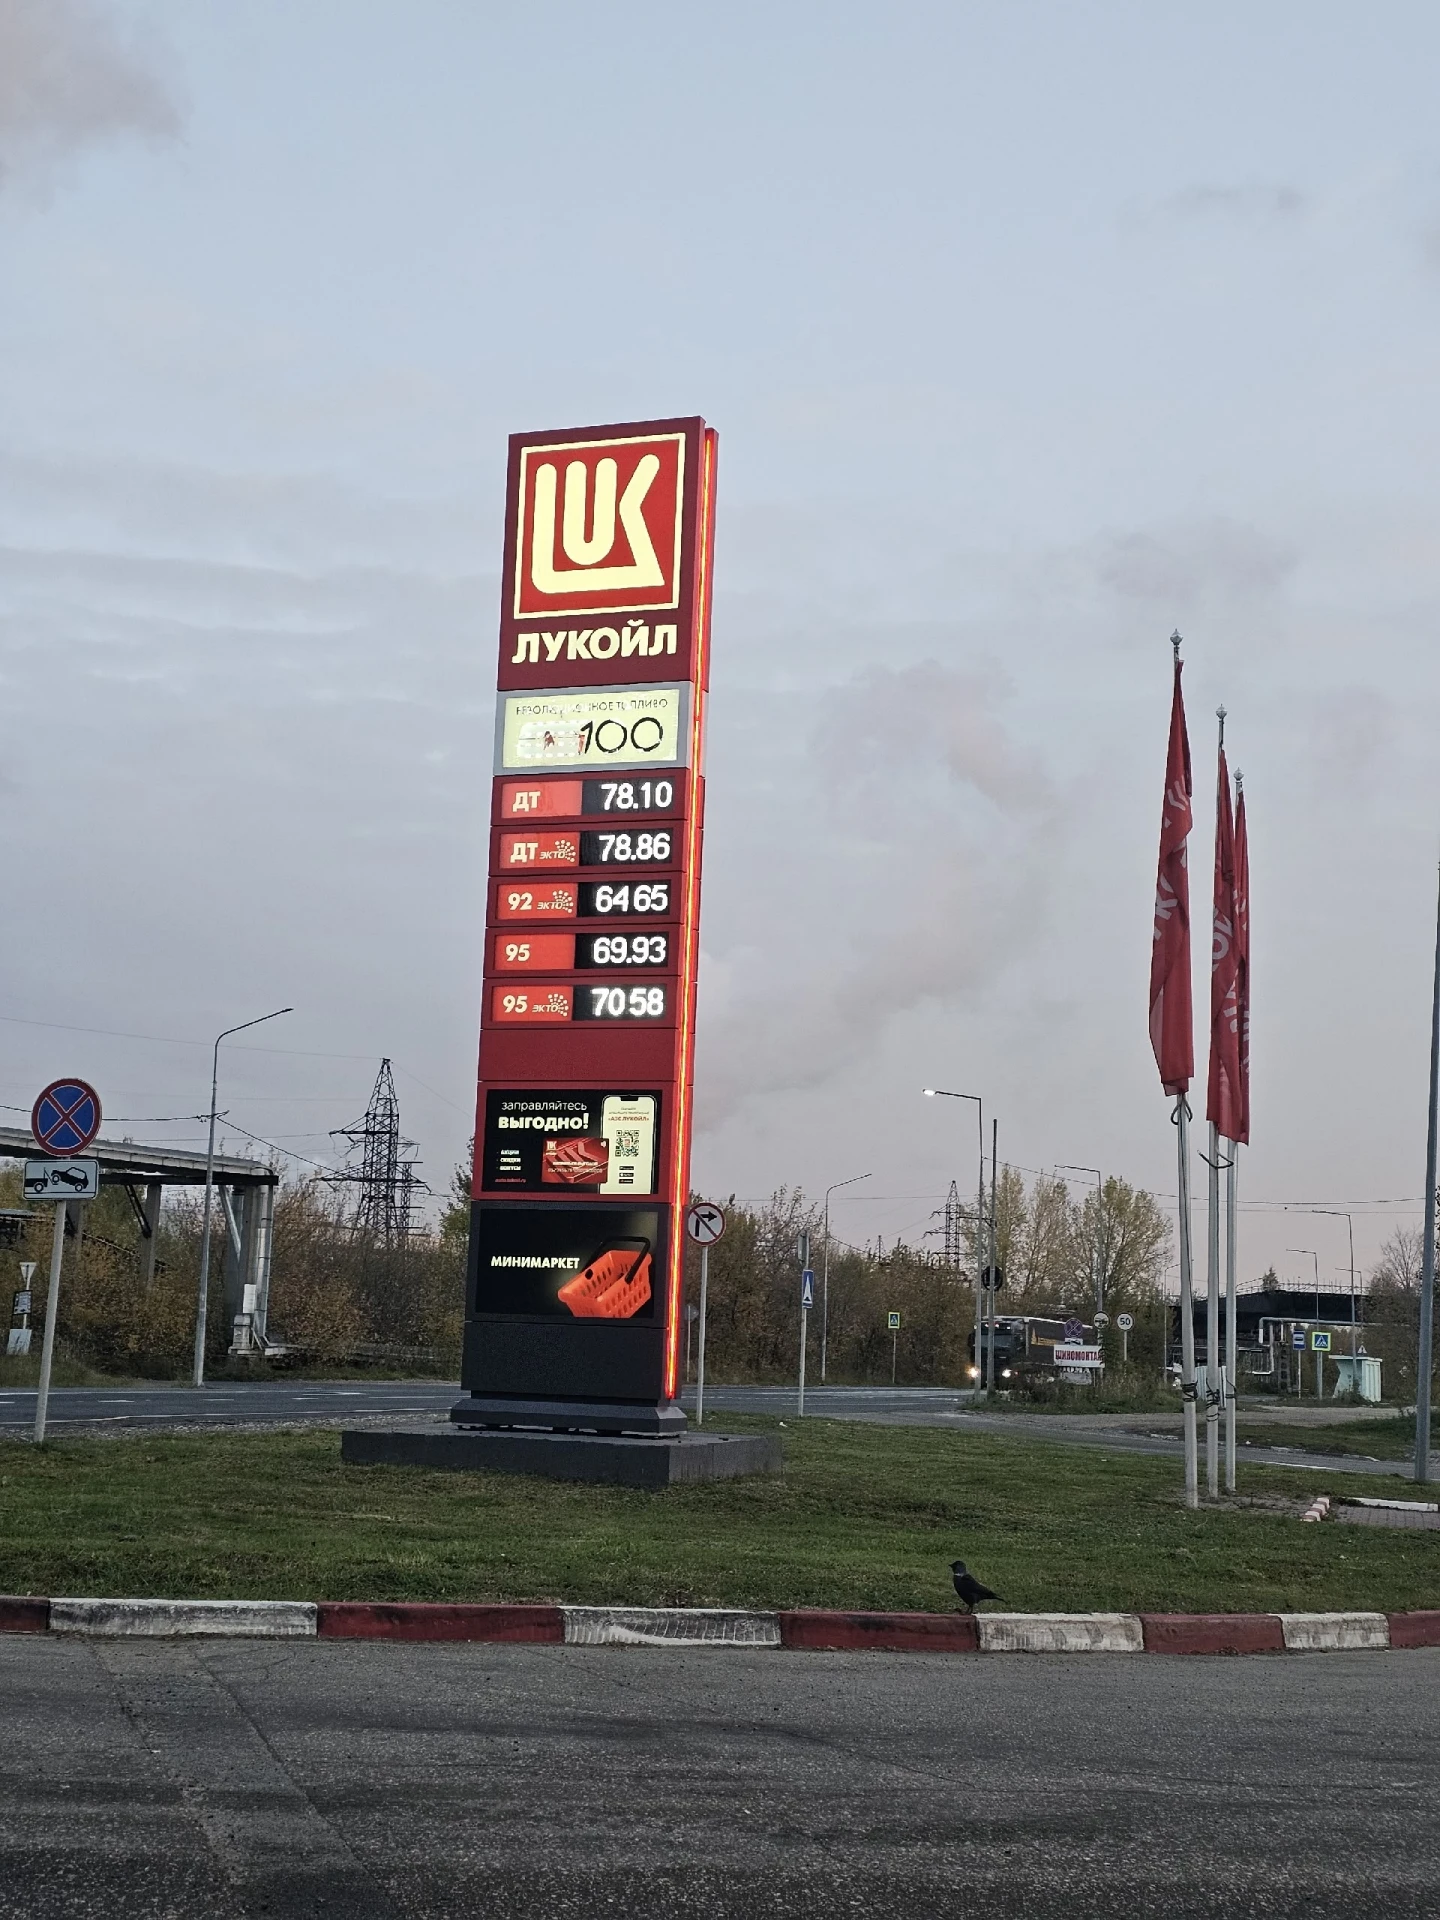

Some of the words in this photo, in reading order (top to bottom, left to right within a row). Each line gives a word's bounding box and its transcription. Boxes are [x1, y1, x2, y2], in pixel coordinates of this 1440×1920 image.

[511, 618, 678, 664] ЛУКОЙЛ
[580, 716, 664, 754] 100
[512, 791, 541, 813] ДТ
[600, 781, 674, 811] 78.10
[509, 842, 538, 864] ДТ
[598, 832, 672, 862] 78.86
[507, 892, 533, 911] 92
[505, 944, 531, 962] 95
[592, 935, 667, 965] 69.93
[502, 995, 528, 1014] 95
[501, 1100, 588, 1113] заправляйтесь
[498, 1112, 590, 1132] выгодно!
[490, 1255, 581, 1270] МИНИМАРКЕТ
[1119, 1317, 1131, 1326] 50
